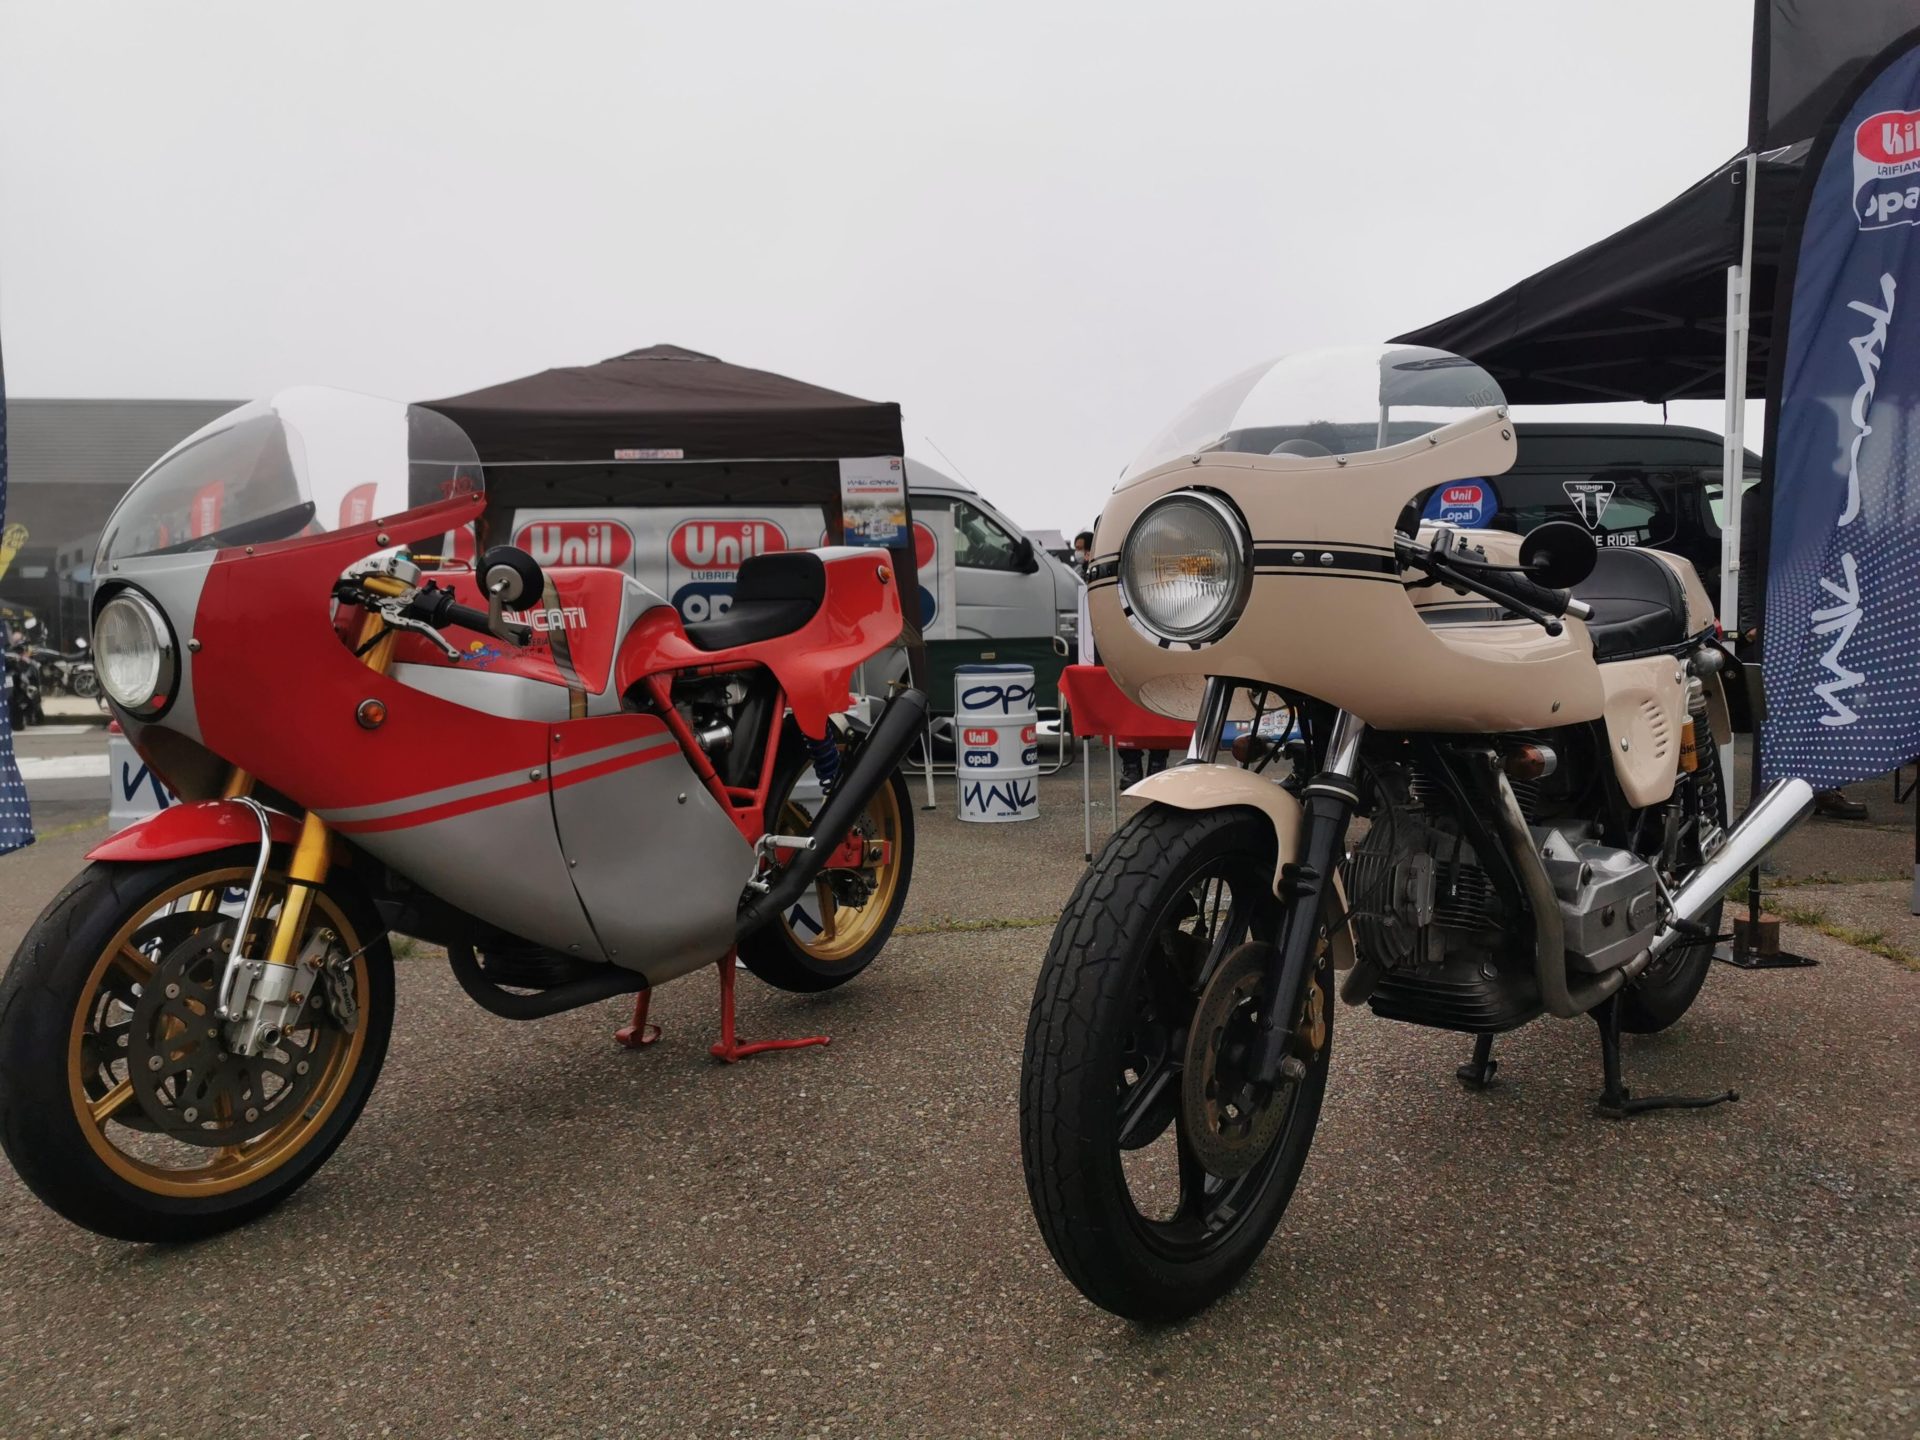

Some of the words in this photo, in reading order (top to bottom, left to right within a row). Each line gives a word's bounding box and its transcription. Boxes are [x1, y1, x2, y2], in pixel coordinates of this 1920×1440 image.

[1450, 490, 1473, 501] Unil
[1447, 510, 1473, 523] opal
[530, 525, 612, 567] Unil
[685, 524, 765, 566] Unil
[1607, 535, 1637, 547] RIDE
[691, 571, 737, 580] LUBRIFI
[682, 594, 734, 622] op
[968, 731, 989, 743] Unil
[968, 752, 992, 766] opal
